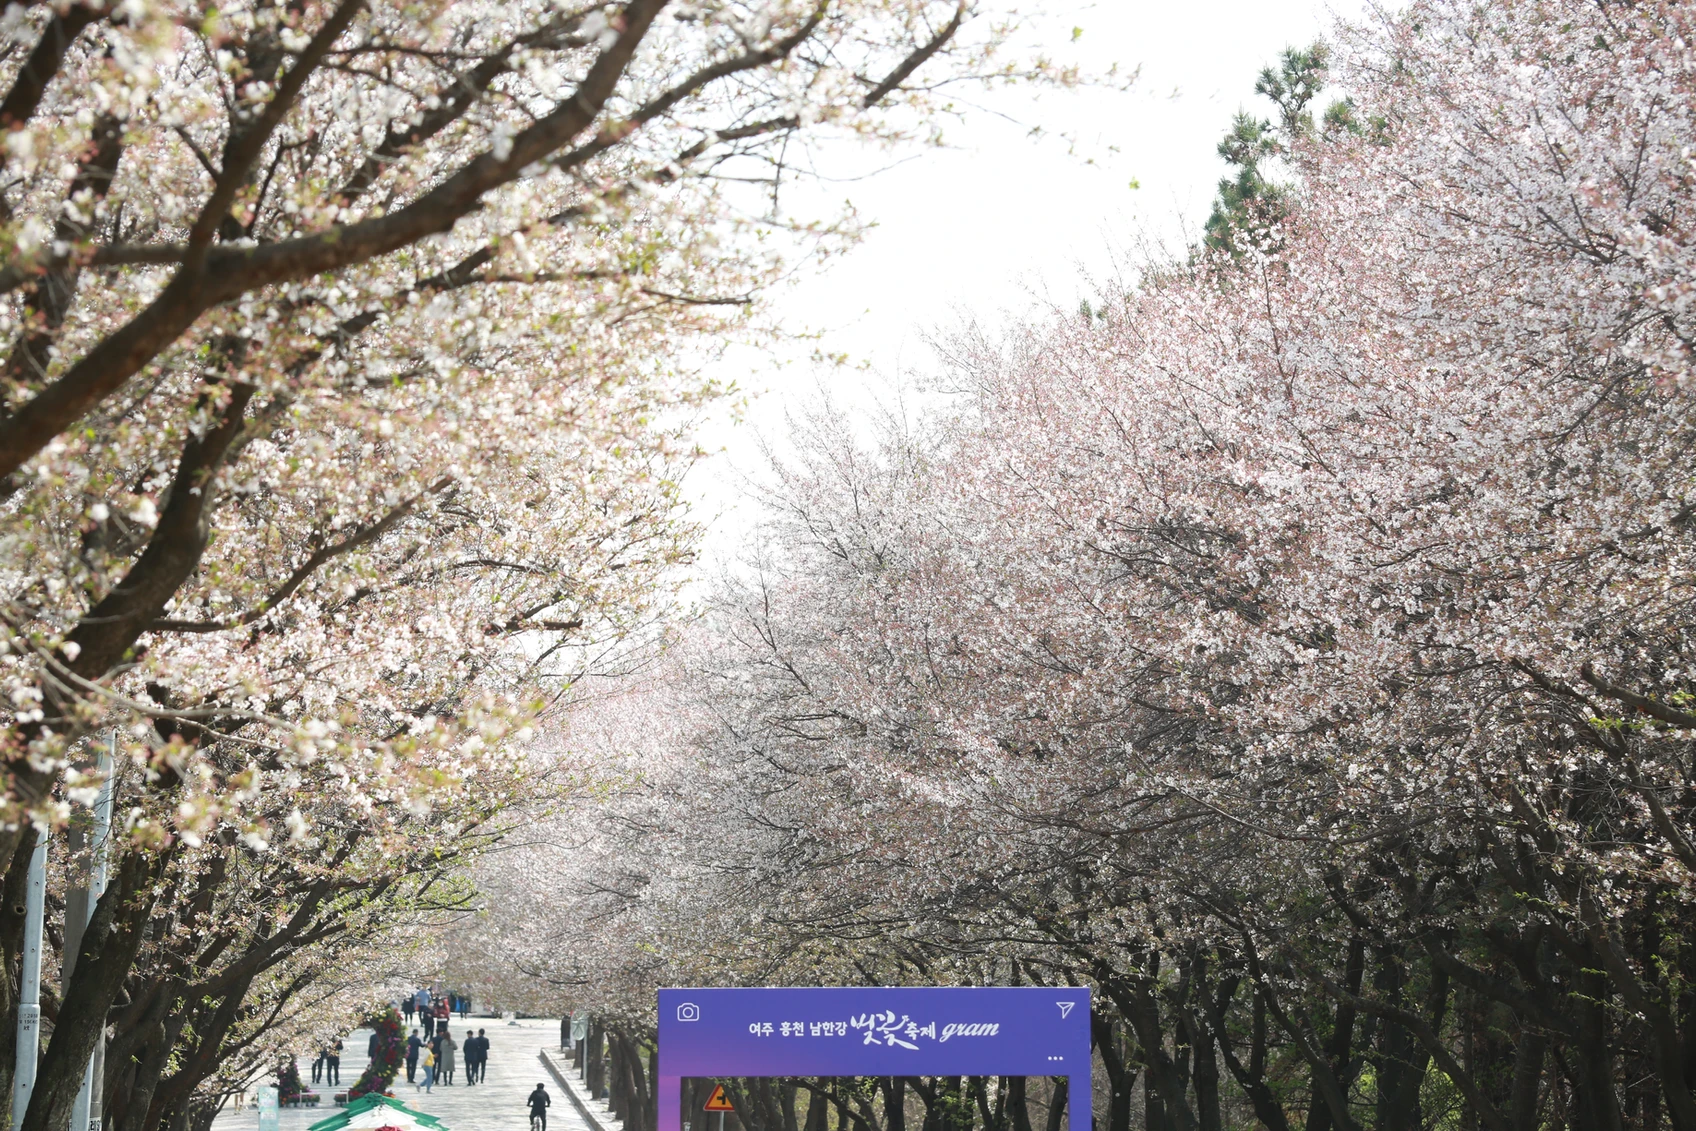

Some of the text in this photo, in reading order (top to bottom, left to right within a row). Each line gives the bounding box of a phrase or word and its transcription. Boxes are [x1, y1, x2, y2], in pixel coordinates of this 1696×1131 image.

[749, 1021, 774, 1037] 여주
[779, 1021, 804, 1037] 흥천
[810, 1021, 847, 1037] 남한강
[939, 1022, 1000, 1043] gram
